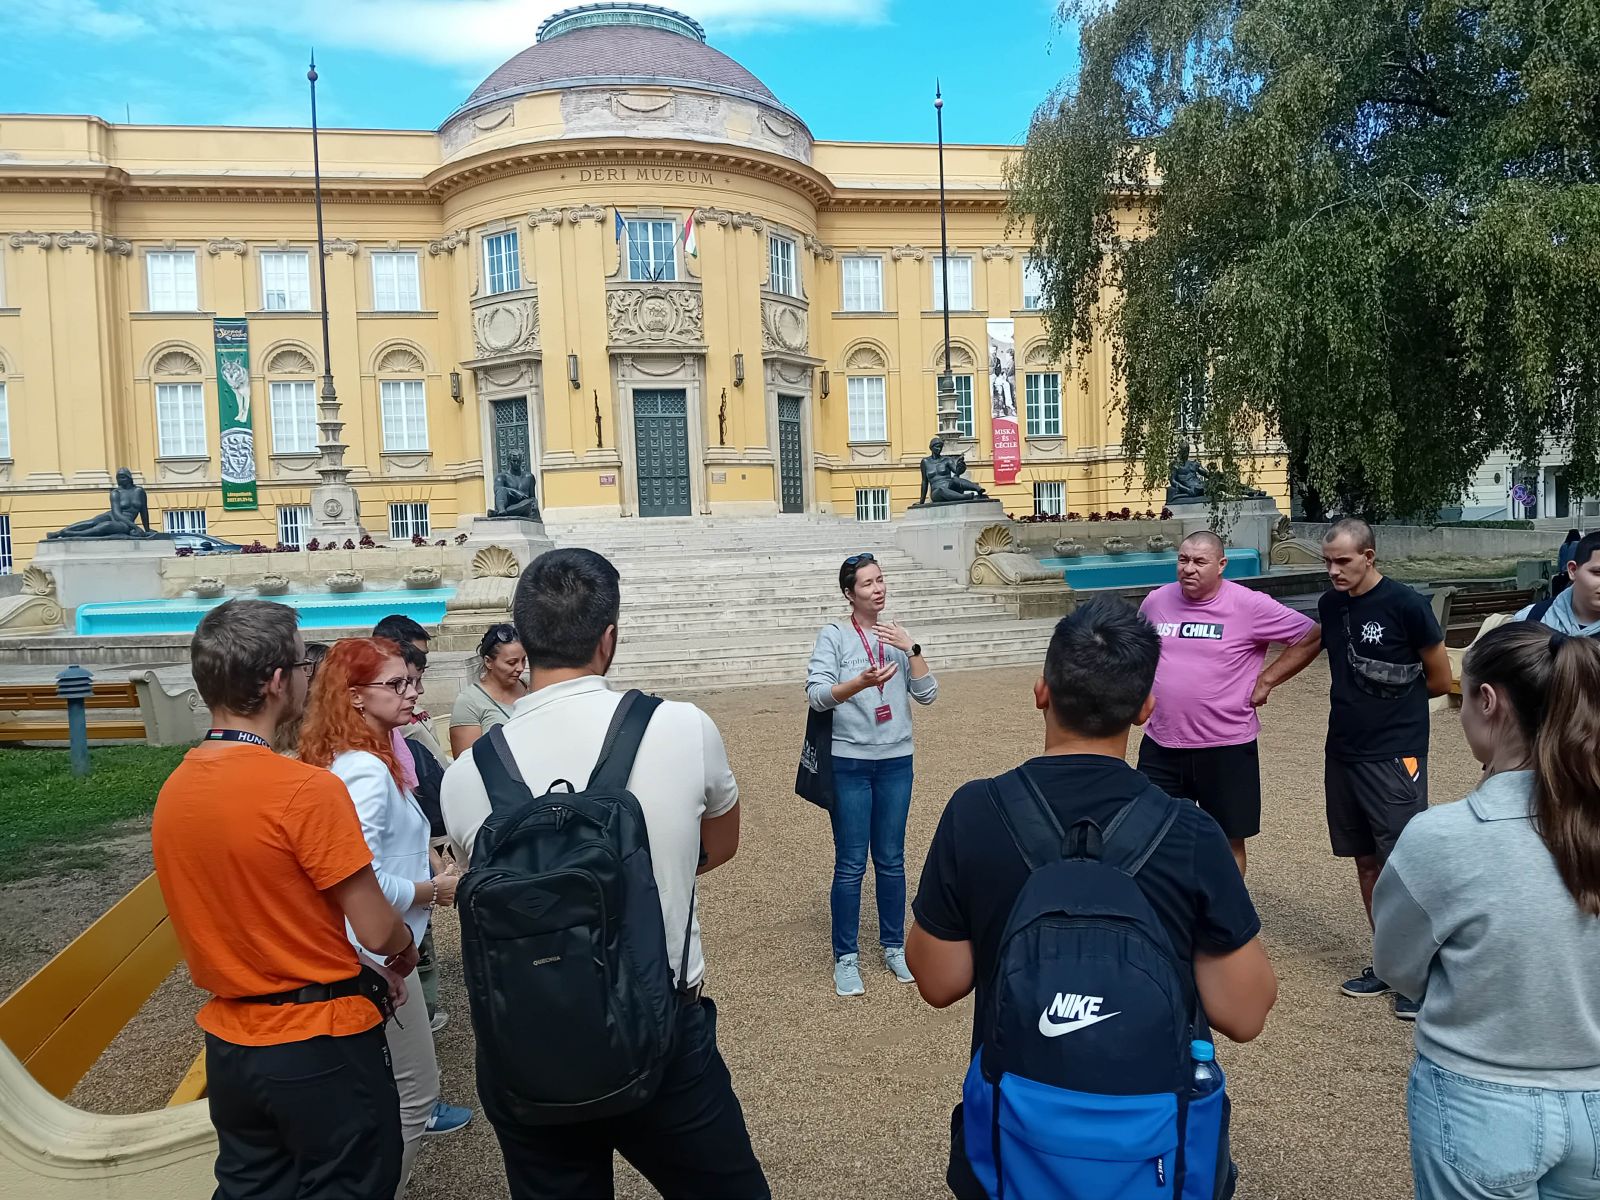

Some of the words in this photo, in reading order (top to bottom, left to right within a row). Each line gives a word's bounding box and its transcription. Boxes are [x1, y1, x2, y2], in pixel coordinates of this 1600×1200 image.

[580, 167, 626, 182] DÉRI
[636, 168, 714, 185] MUZEUM
[994, 441, 1018, 449] CÉCILE
[1182, 624, 1221, 639] CHILL.
[1048, 992, 1104, 1020] NIKE
